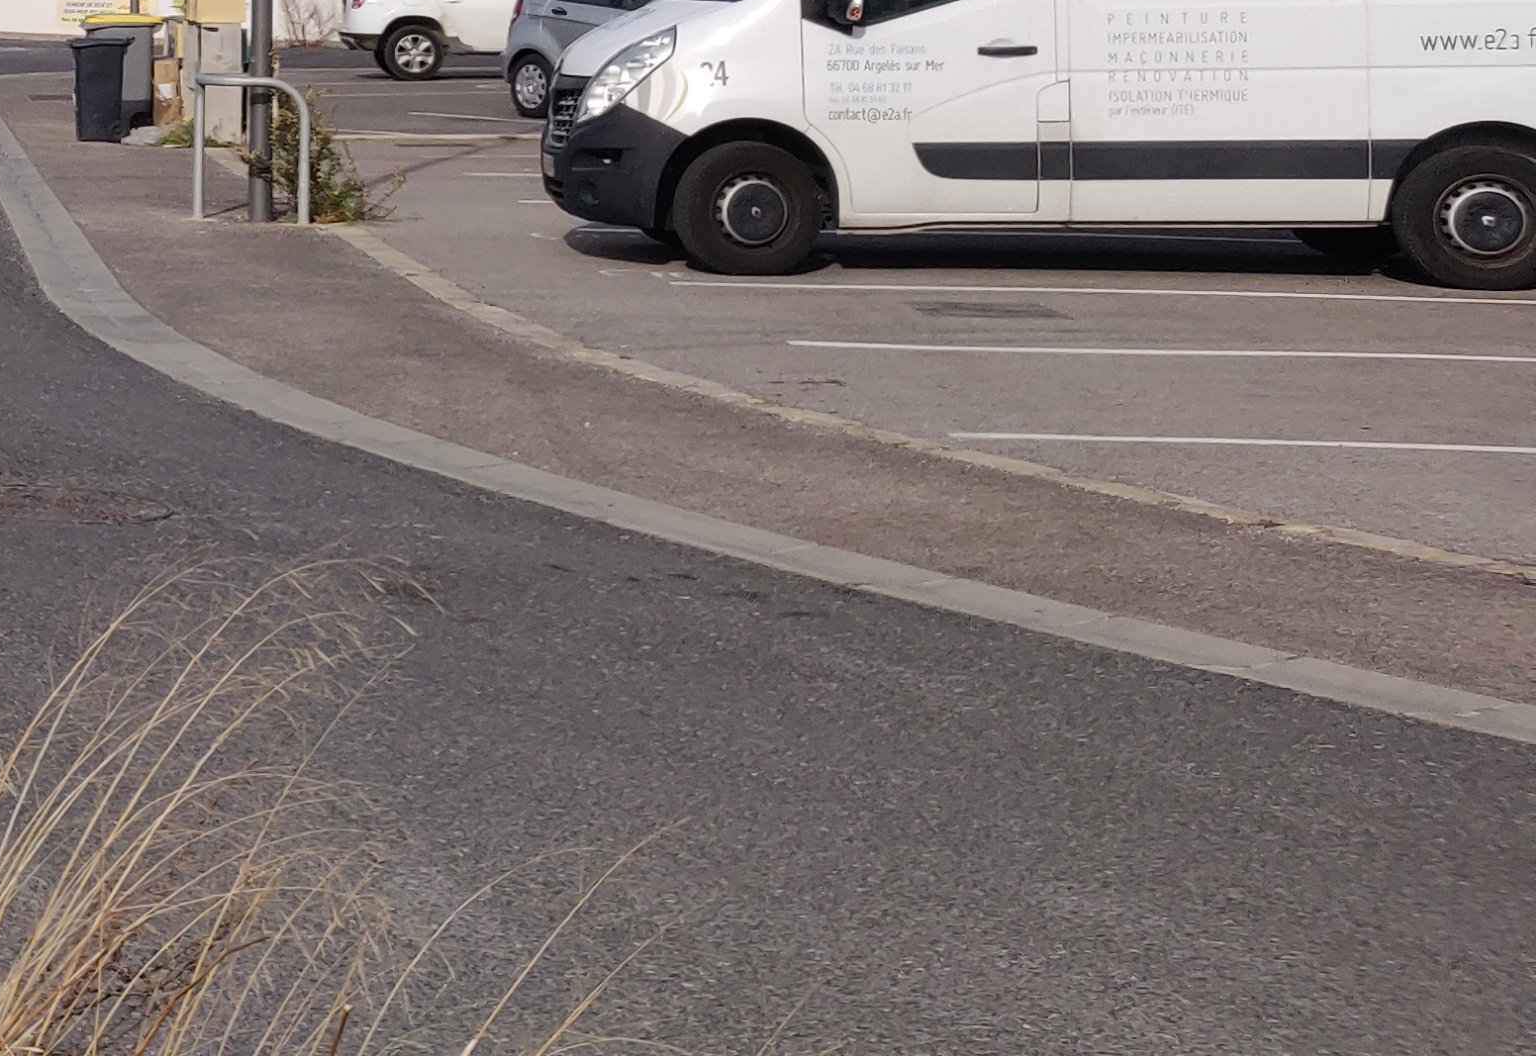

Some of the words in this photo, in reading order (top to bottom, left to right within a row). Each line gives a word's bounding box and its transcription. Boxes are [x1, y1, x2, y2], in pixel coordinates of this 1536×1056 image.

[1107, 11, 1248, 25] PEINTURE
[1107, 49, 1249, 65] MAÇONNERIE
[827, 60, 859, 71] 66700
[905, 62, 920, 71] sur
[926, 60, 945, 71] Mer
[1108, 90, 1172, 103] ISOLATION
[828, 107, 913, 124] contact@e2a.fr
